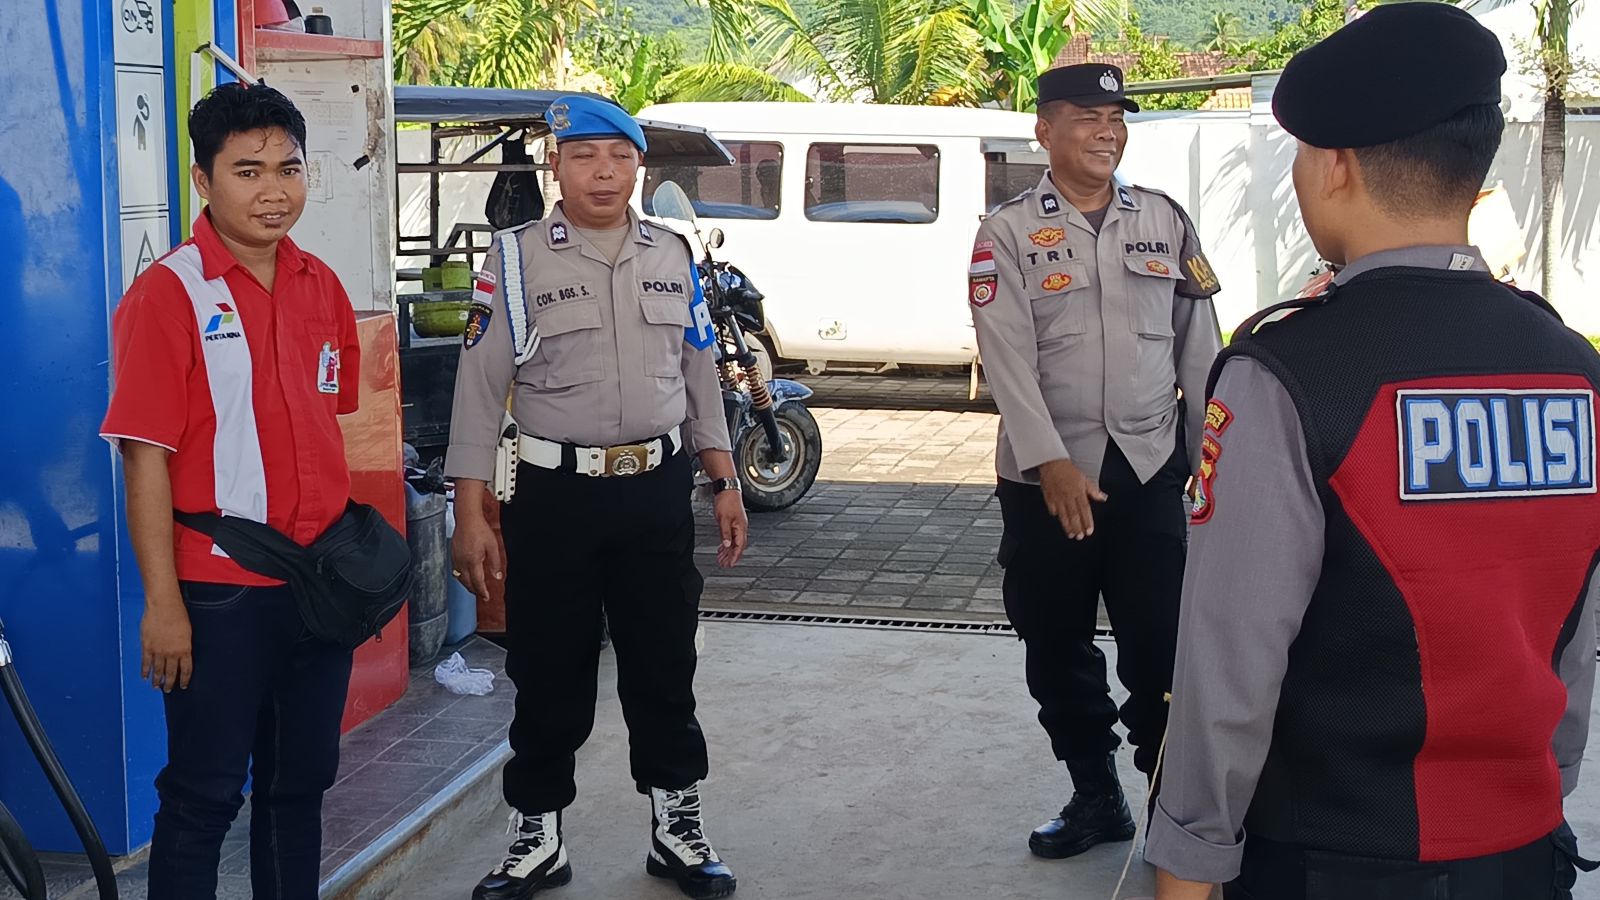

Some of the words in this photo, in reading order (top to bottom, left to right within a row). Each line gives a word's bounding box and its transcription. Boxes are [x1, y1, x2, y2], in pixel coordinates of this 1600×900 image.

[1125, 241, 1170, 255] POLRI
[558, 287, 579, 301] BGS.
[580, 285, 590, 296] S.
[642, 281, 683, 294] POLRI
[1405, 398, 1591, 490] POLISI
